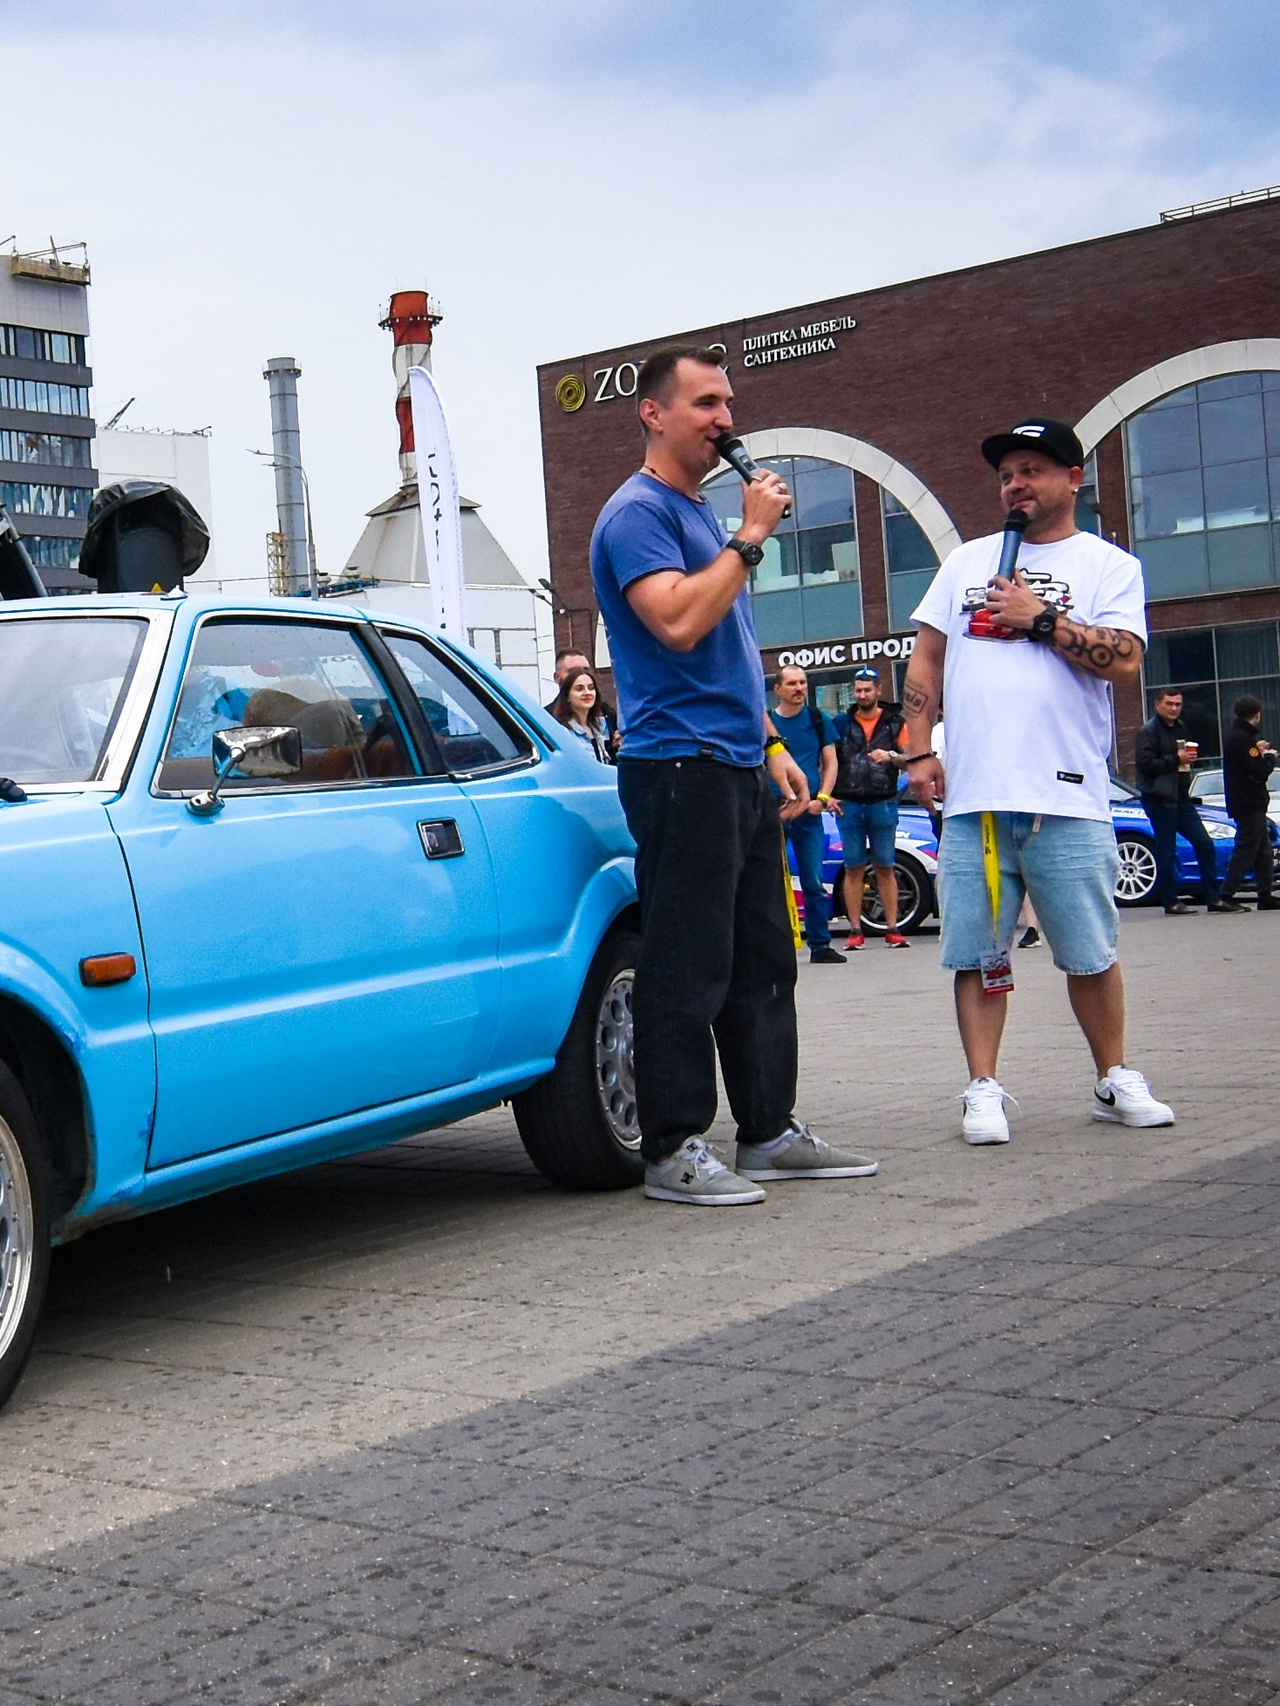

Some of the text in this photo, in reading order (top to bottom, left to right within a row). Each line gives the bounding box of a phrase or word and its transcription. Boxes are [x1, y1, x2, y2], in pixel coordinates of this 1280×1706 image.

[743, 316, 856, 351] ПЛИТКА МЕБЕЛЬ
[744, 337, 837, 367] САНТЕХНИКА
[778, 645, 846, 668] ОФИС
